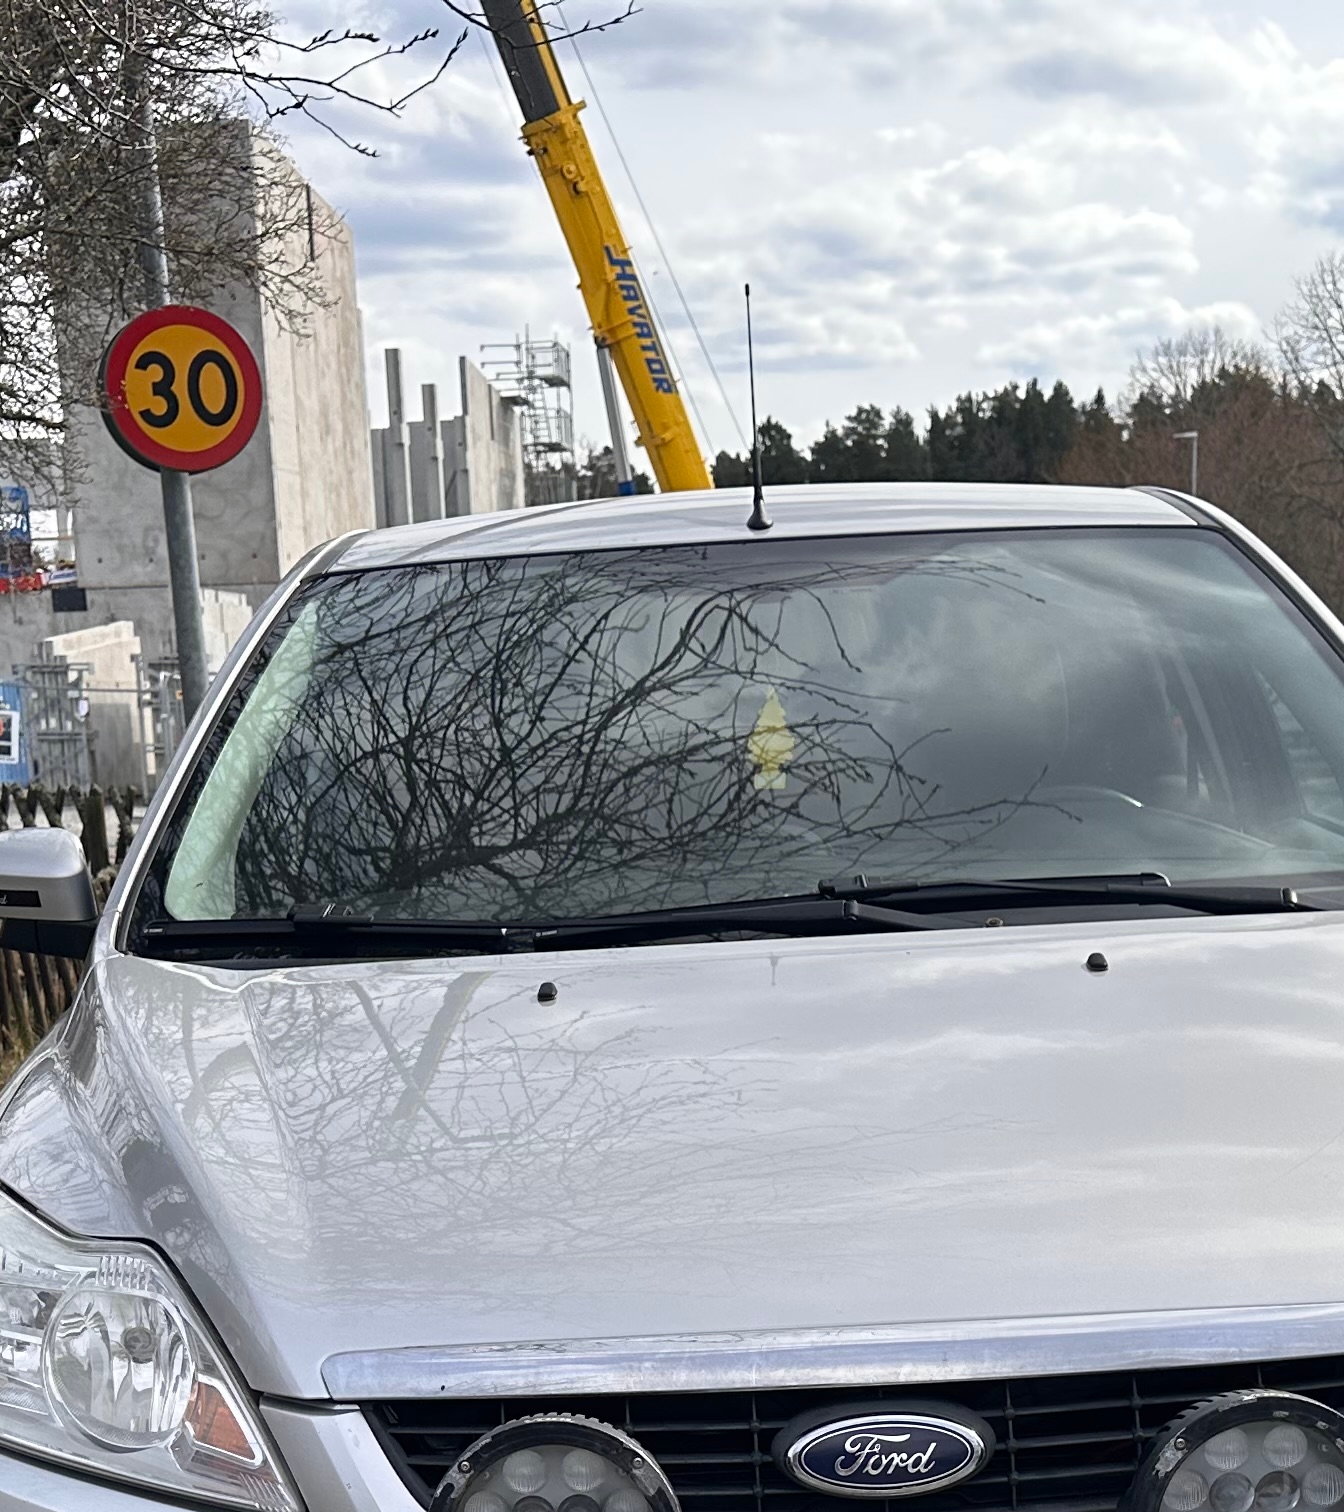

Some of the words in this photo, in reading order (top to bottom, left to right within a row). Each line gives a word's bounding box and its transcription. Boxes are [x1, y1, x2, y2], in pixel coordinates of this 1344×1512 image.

[603, 244, 674, 394] HAVATOR
[134, 349, 238, 429] 30
[834, 1433, 937, 1477] Ford
